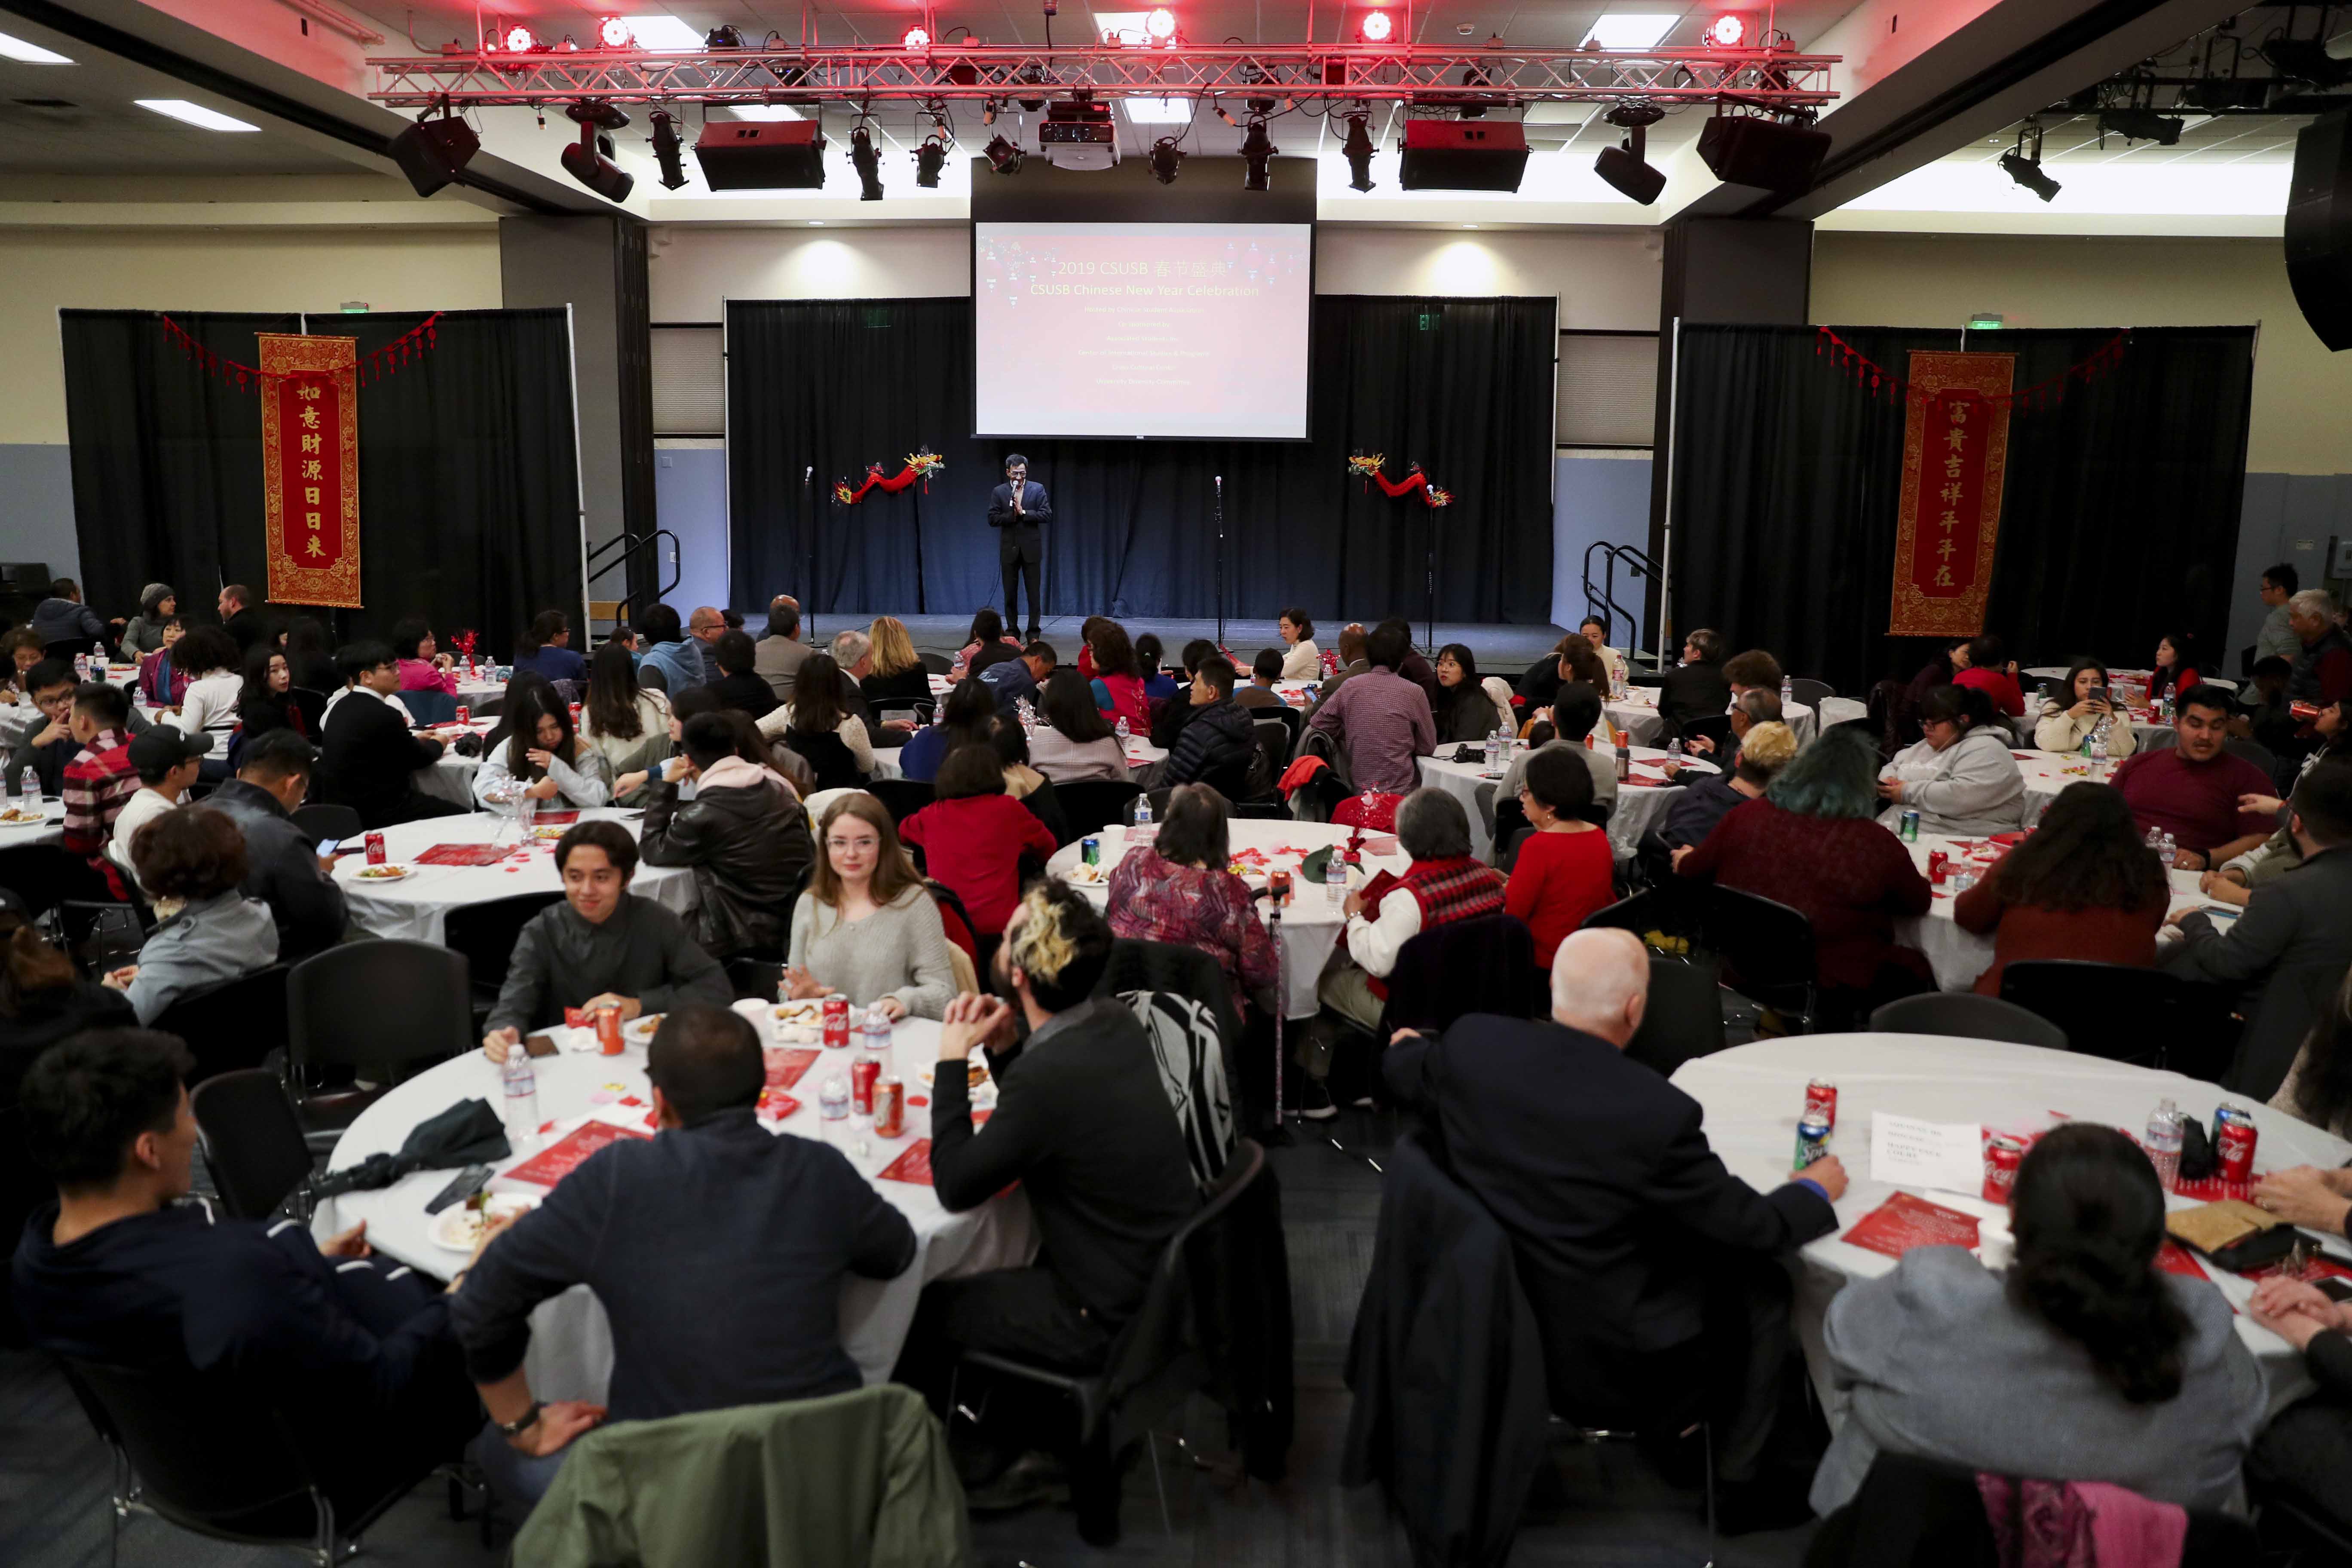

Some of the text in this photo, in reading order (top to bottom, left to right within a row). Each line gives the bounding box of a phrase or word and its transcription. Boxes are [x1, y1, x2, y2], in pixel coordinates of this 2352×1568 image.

[1058, 260, 1228, 278] 2019 CSUSB 春节盛典
[1030, 284, 1259, 296] CSUSB Chinese New Year Celebration
